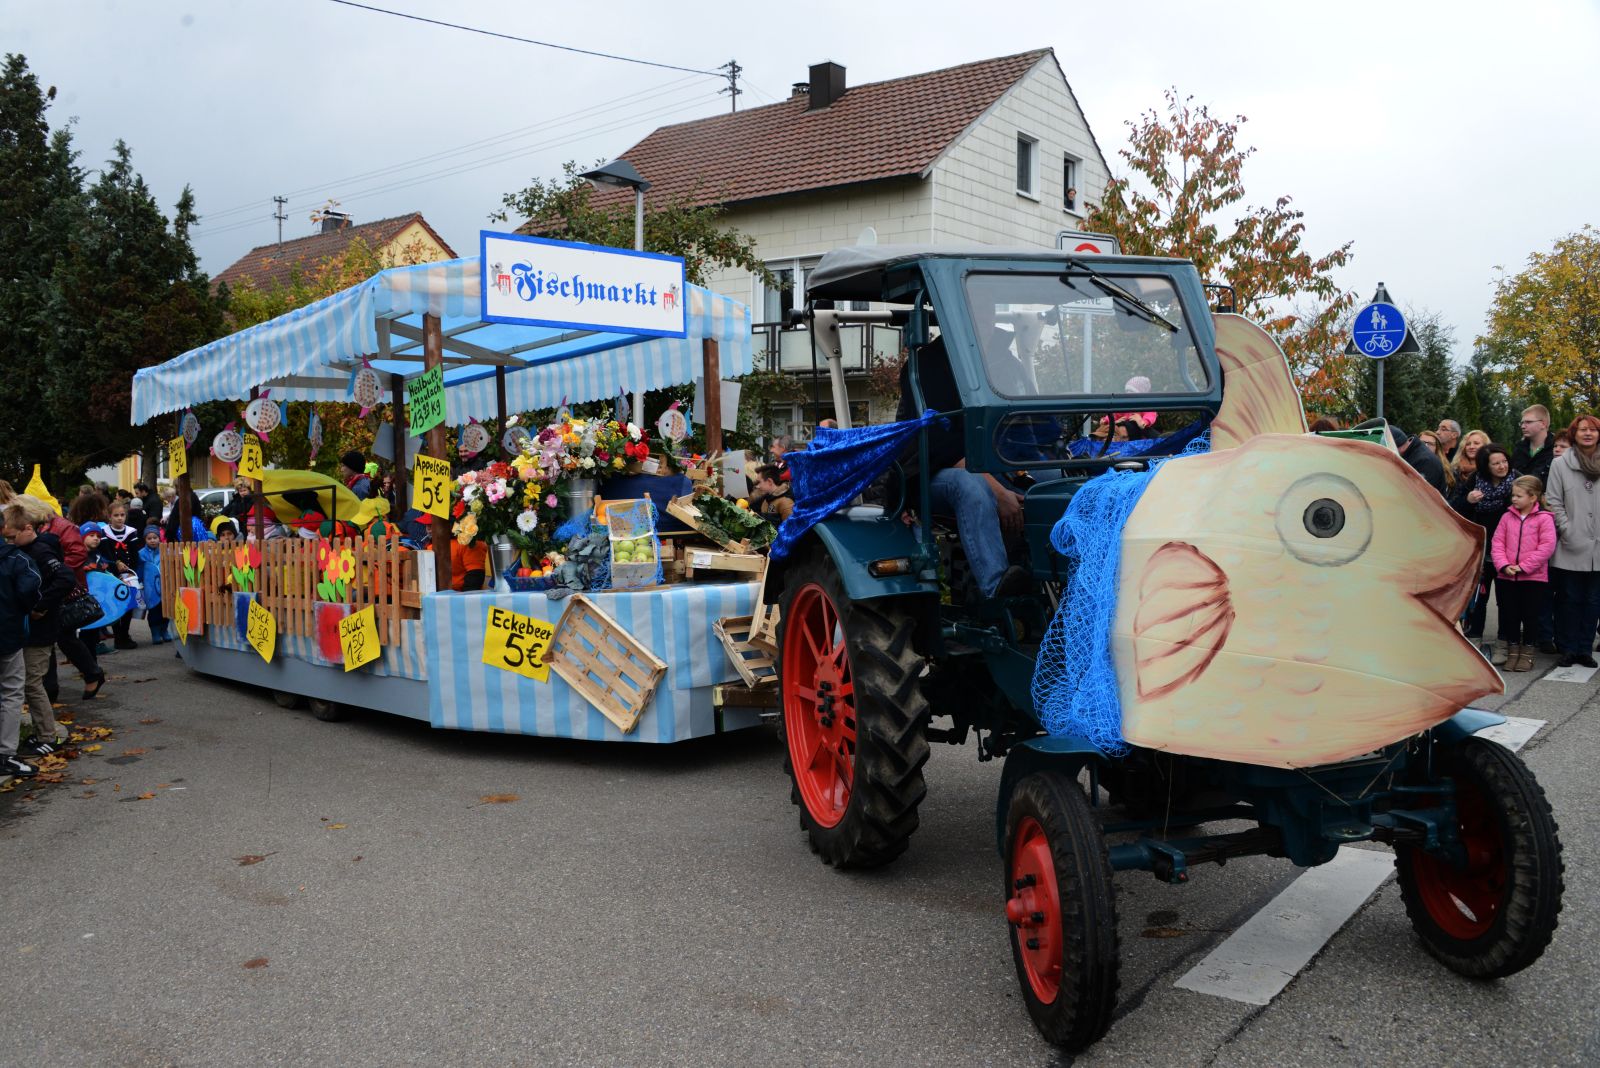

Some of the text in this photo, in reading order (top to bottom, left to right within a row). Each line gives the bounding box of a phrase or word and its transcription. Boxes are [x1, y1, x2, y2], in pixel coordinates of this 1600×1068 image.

[511, 259, 657, 306] Fischmarkt
[408, 369, 439, 397] Heilbutt
[416, 456, 450, 477] Appelsien
[250, 600, 270, 625] Stück
[341, 612, 365, 638] Stück
[492, 608, 552, 640] Eckebeer
